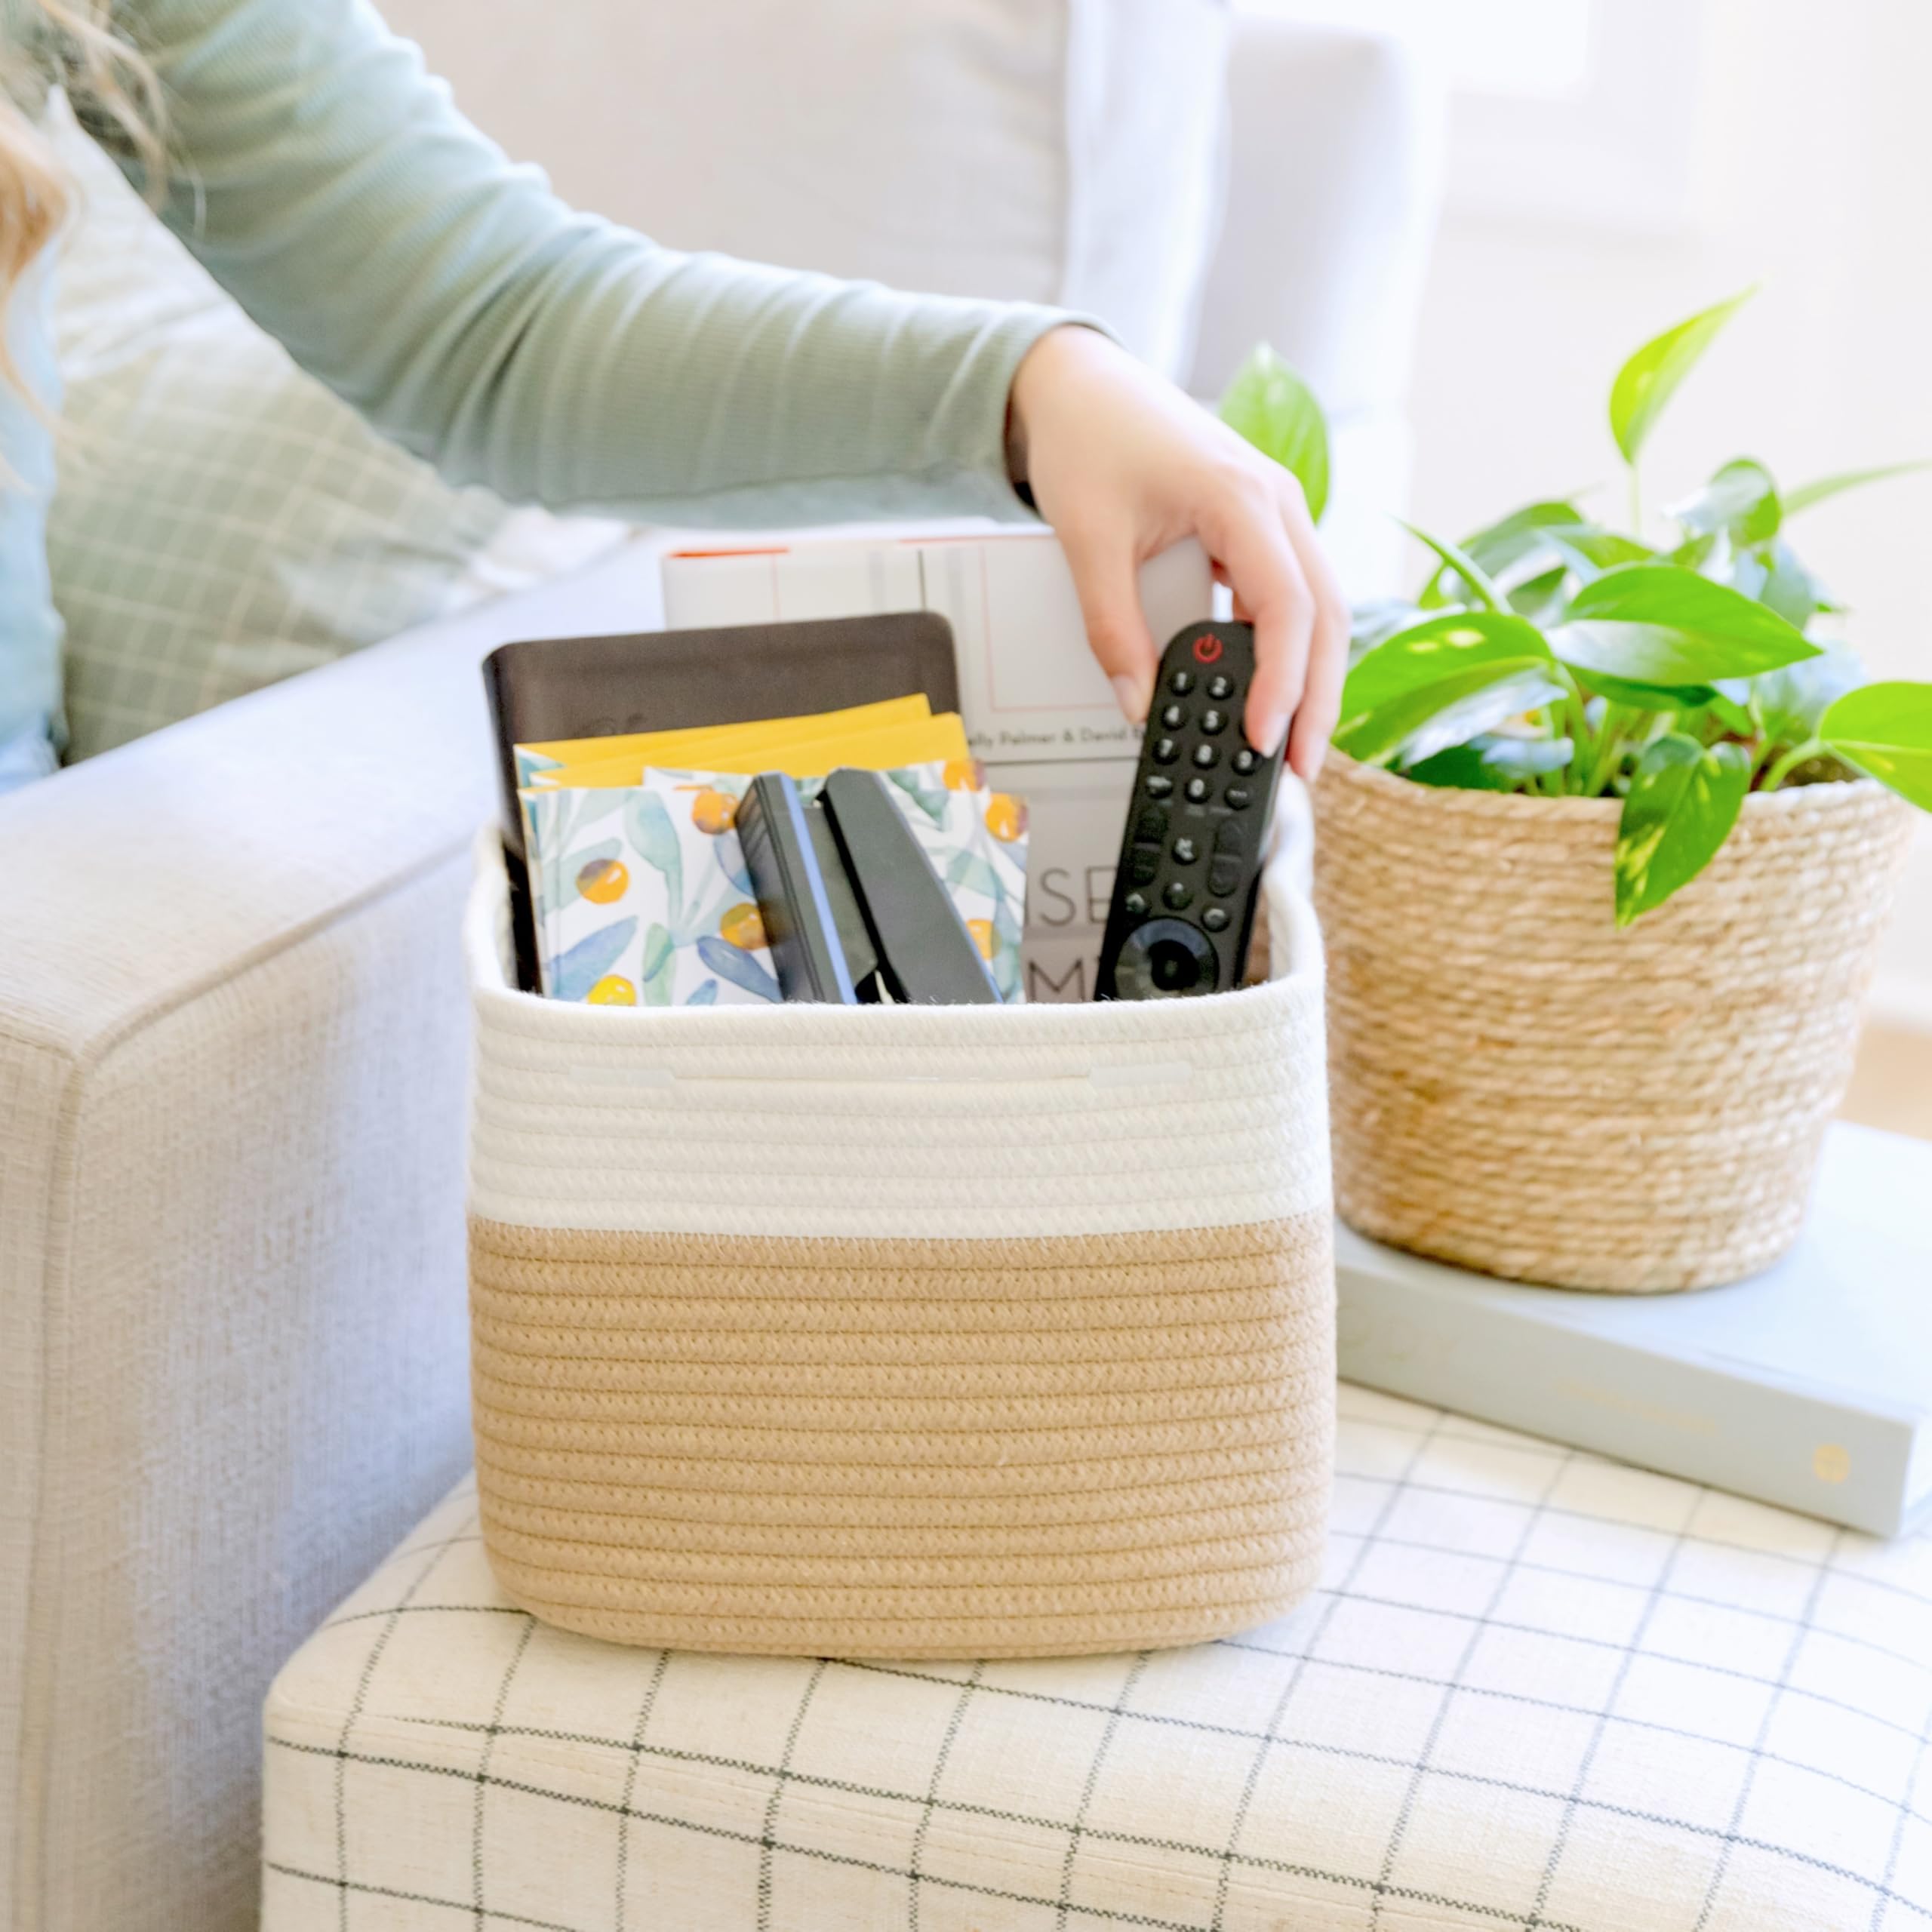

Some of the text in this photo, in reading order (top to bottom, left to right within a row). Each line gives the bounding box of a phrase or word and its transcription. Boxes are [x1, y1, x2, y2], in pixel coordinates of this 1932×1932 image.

[1177, 672, 1226, 696] 1 2
[1164, 706, 1219, 729] 4 5
[999, 728, 1056, 745] Palmer
[1063, 727, 1075, 743] &
[1161, 738, 1173, 757] 7
[1237, 750, 1253, 769] 9
[1025, 865, 1118, 927] SE
[1028, 954, 1100, 1003] M
